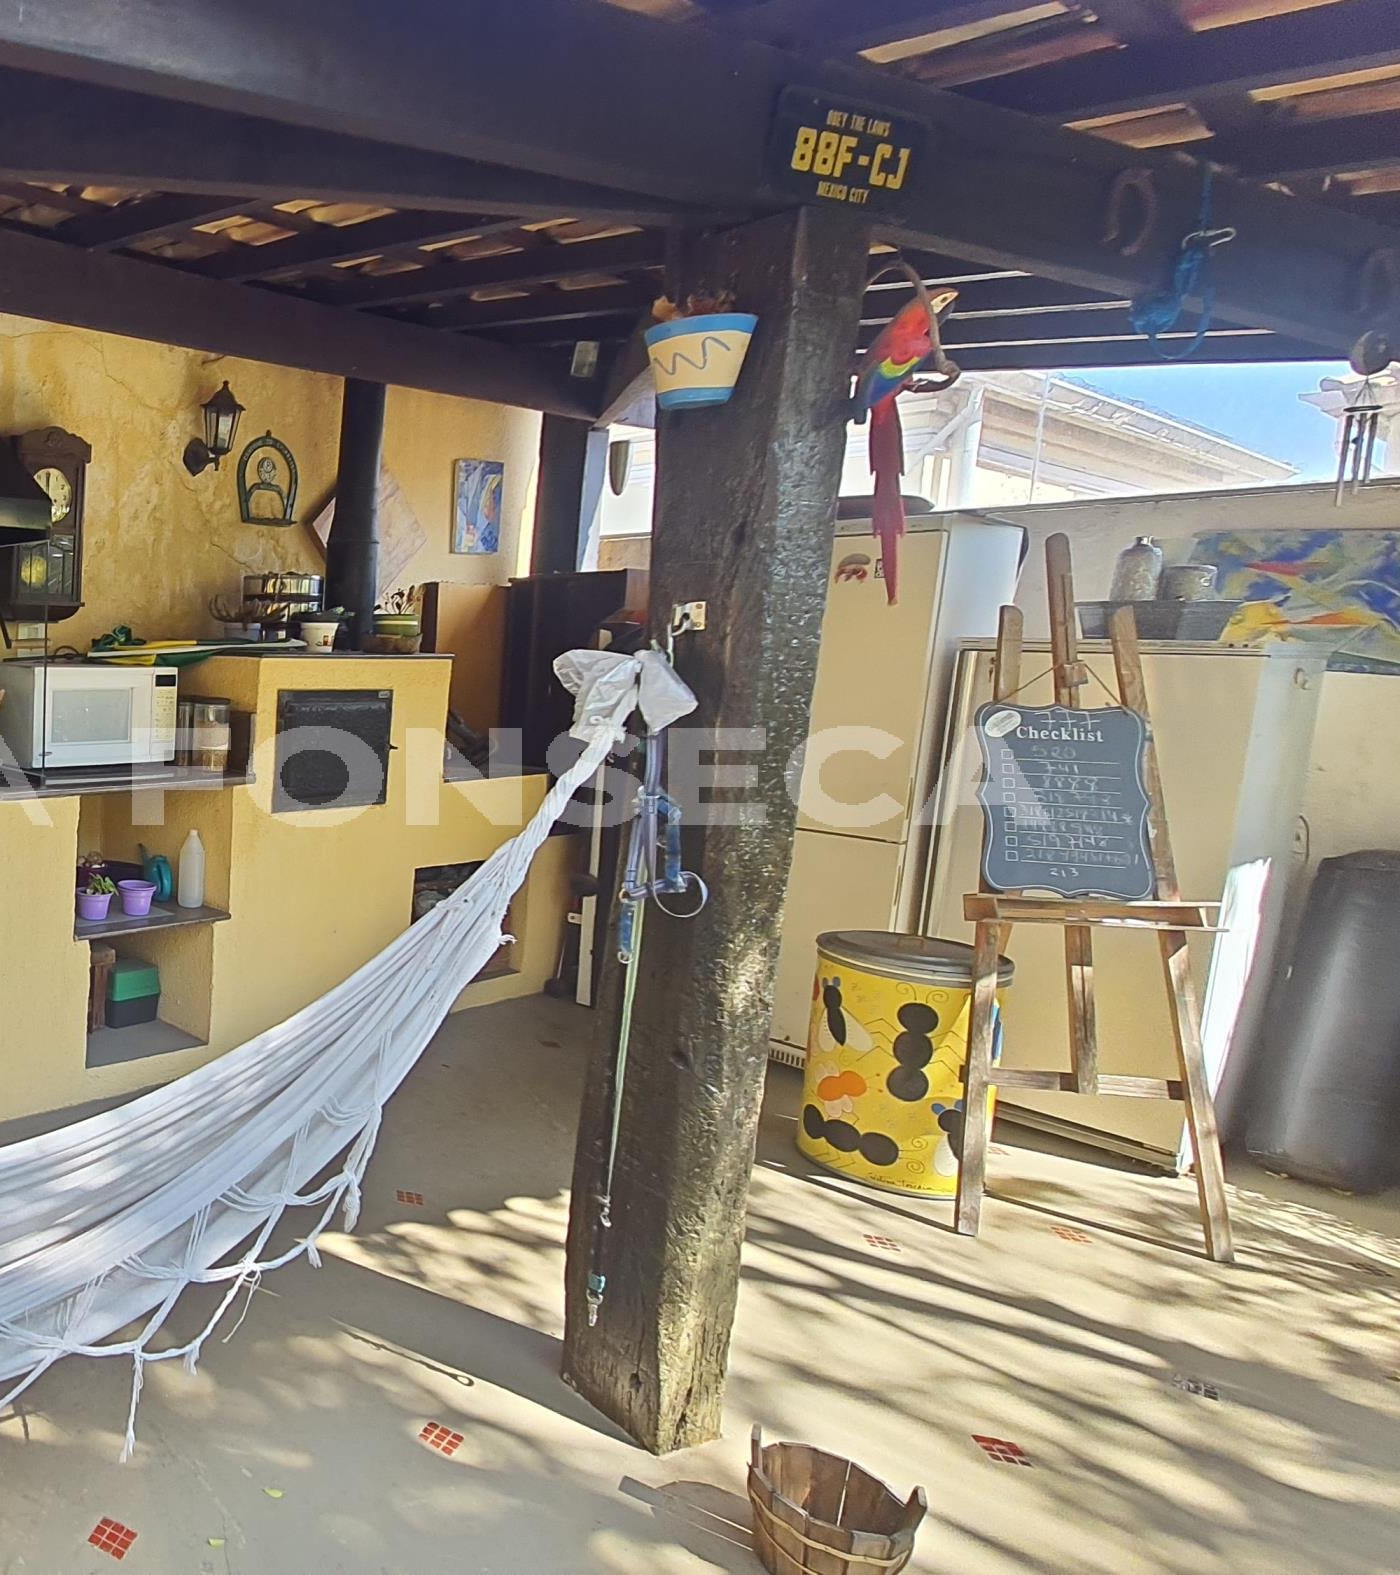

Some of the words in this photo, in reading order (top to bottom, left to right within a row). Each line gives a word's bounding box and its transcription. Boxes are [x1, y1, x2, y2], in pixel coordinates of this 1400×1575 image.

[850, 114, 868, 132] THE
[790, 126, 912, 190] 88F-CJ
[816, 180, 848, 200] MEXICO
[849, 187, 870, 204] CITY
[1016, 725, 1104, 742] Checklist
